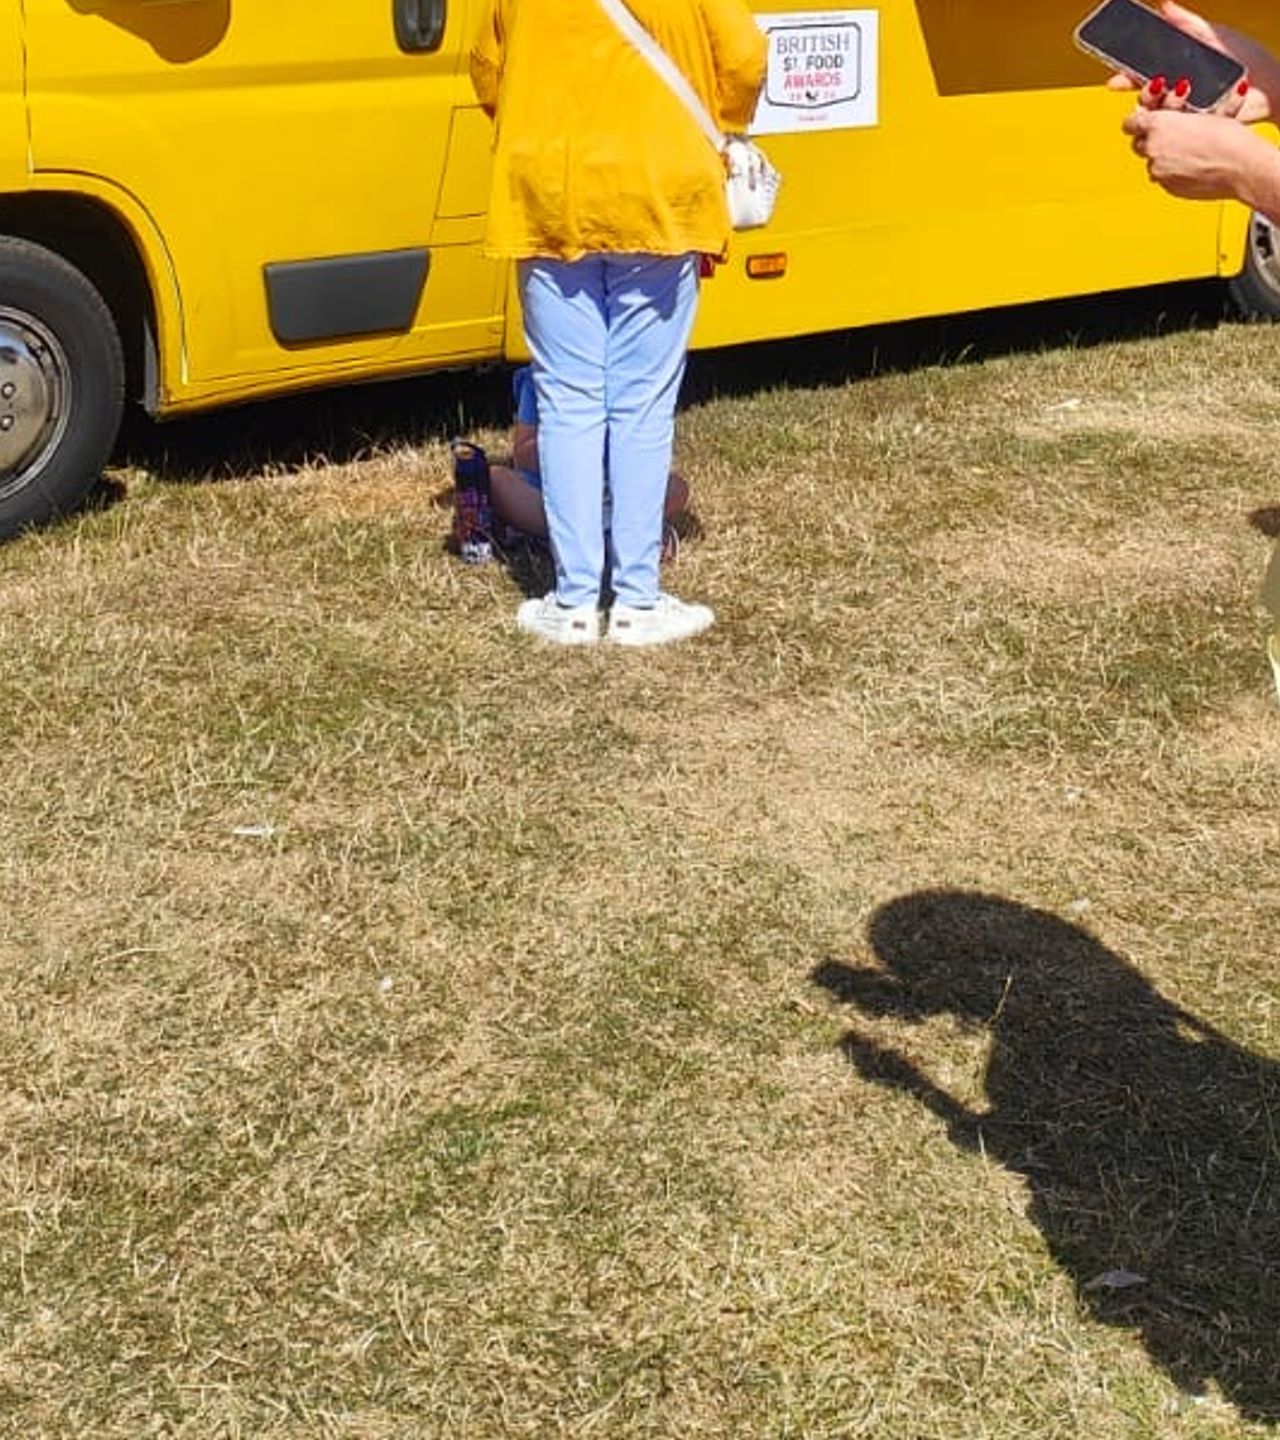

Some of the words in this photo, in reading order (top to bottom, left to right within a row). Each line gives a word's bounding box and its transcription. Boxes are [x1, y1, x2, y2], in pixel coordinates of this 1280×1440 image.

[776, 32, 850, 55] BRITISH
[806, 54, 844, 71] FOOD
[784, 72, 842, 91] AWARDS
